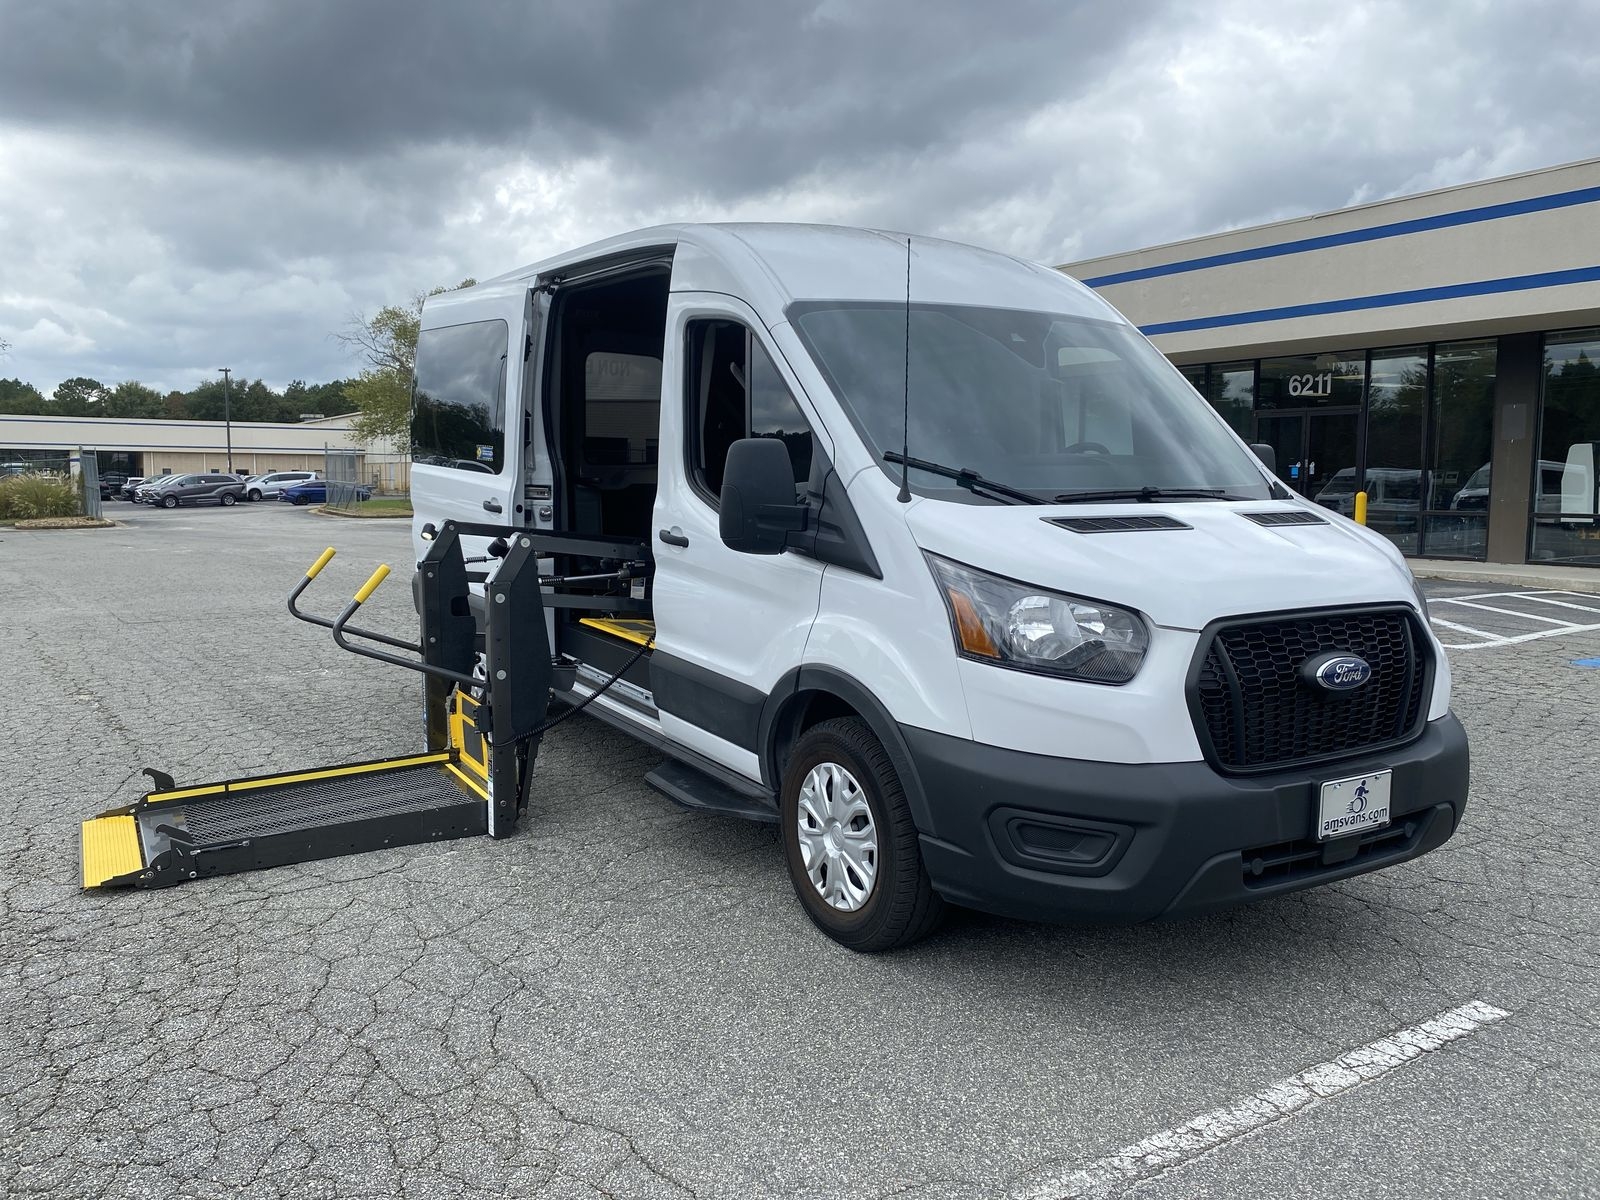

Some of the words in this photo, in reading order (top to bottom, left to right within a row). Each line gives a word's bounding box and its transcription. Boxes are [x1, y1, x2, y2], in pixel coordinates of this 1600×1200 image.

[1288, 372, 1332, 396] 6211
[1333, 662, 1363, 683] Ford
[1323, 806, 1388, 831] amsvans.com
